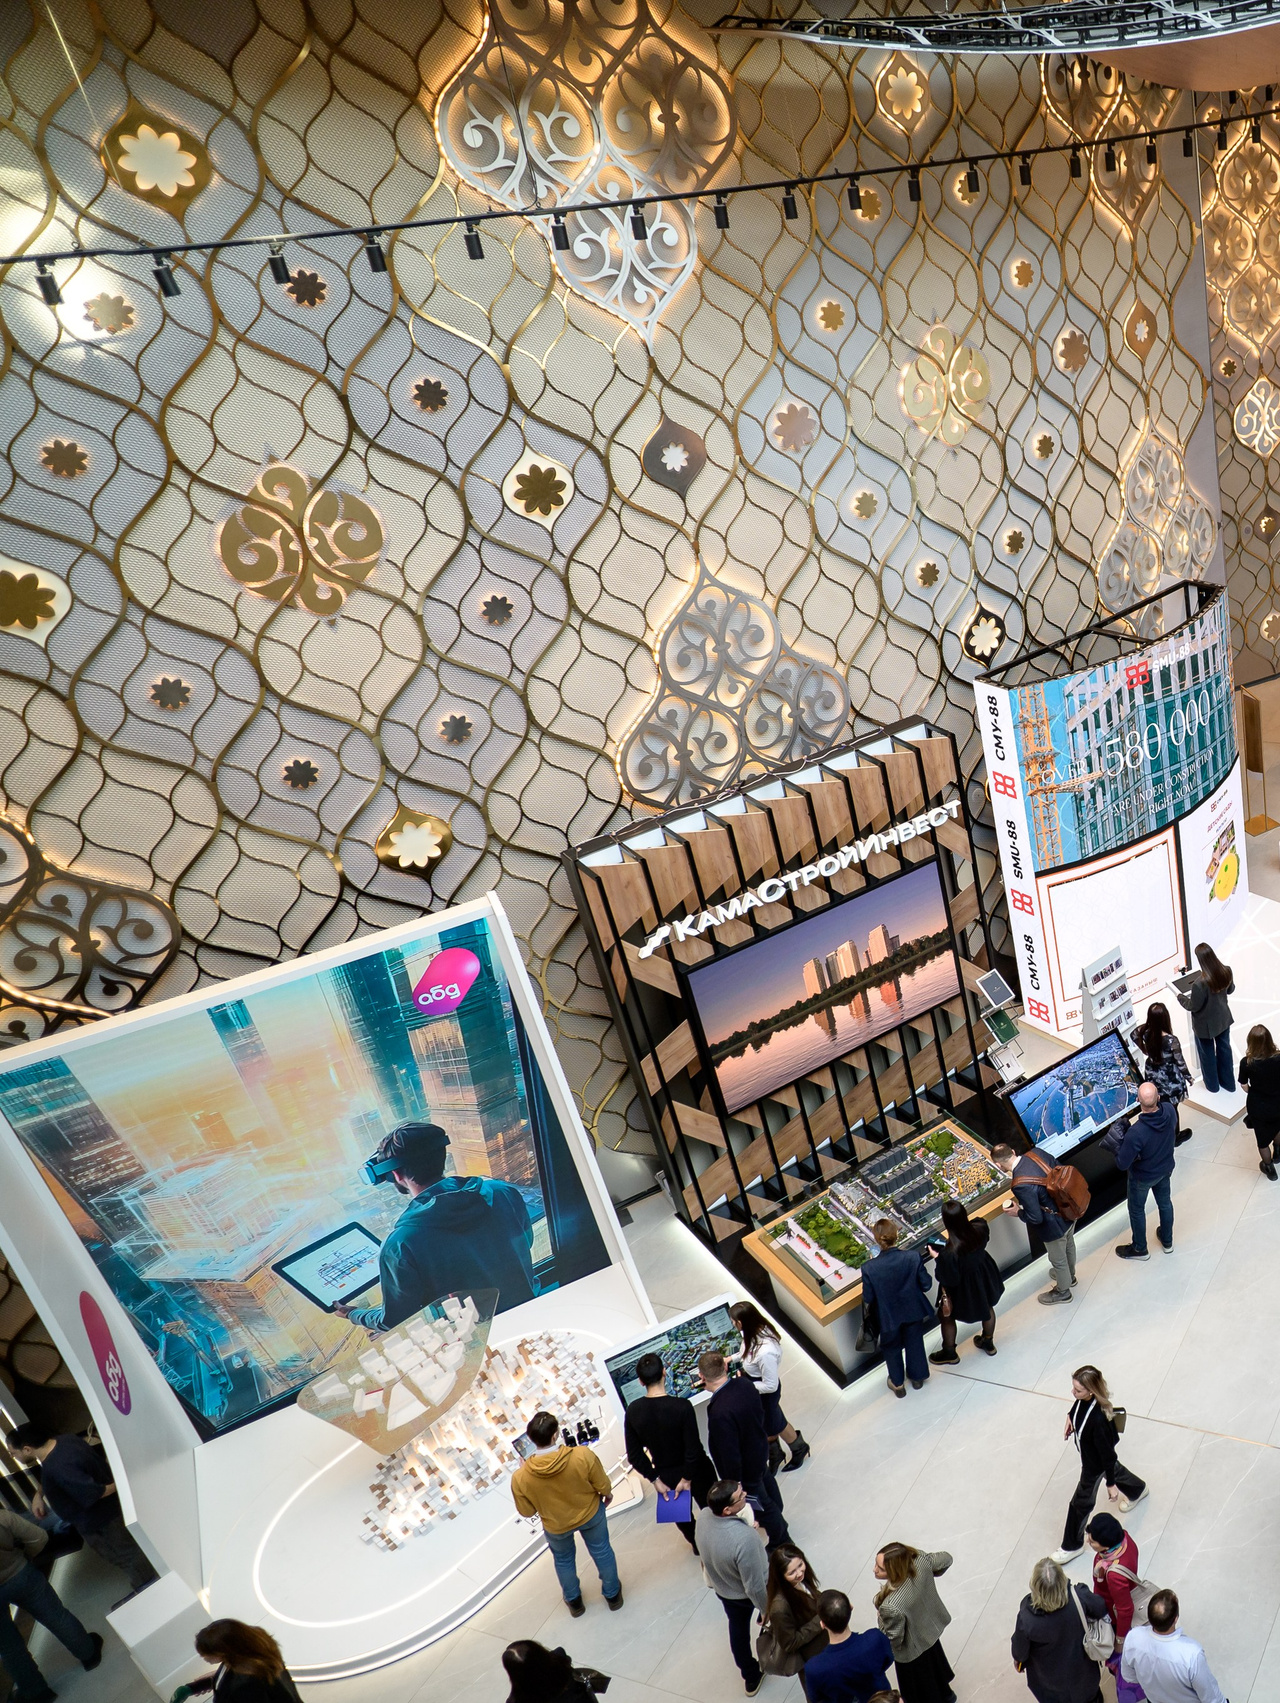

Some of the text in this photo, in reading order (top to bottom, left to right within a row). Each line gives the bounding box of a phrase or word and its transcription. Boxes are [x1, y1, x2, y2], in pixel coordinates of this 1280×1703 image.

[1152, 642, 1191, 673] SMU-88
[987, 695, 1006, 761] СМУ-88
[1041, 758, 1087, 784] OVER
[1105, 722, 1162, 778] 580
[1170, 689, 1211, 746] 000
[1111, 747, 1214, 816] ARE UNDER CONSTRUCTION
[1149, 781, 1195, 816] RIGHT NOW
[1006, 819, 1024, 880] SMU-88
[1023, 934, 1040, 991] СМУ-88
